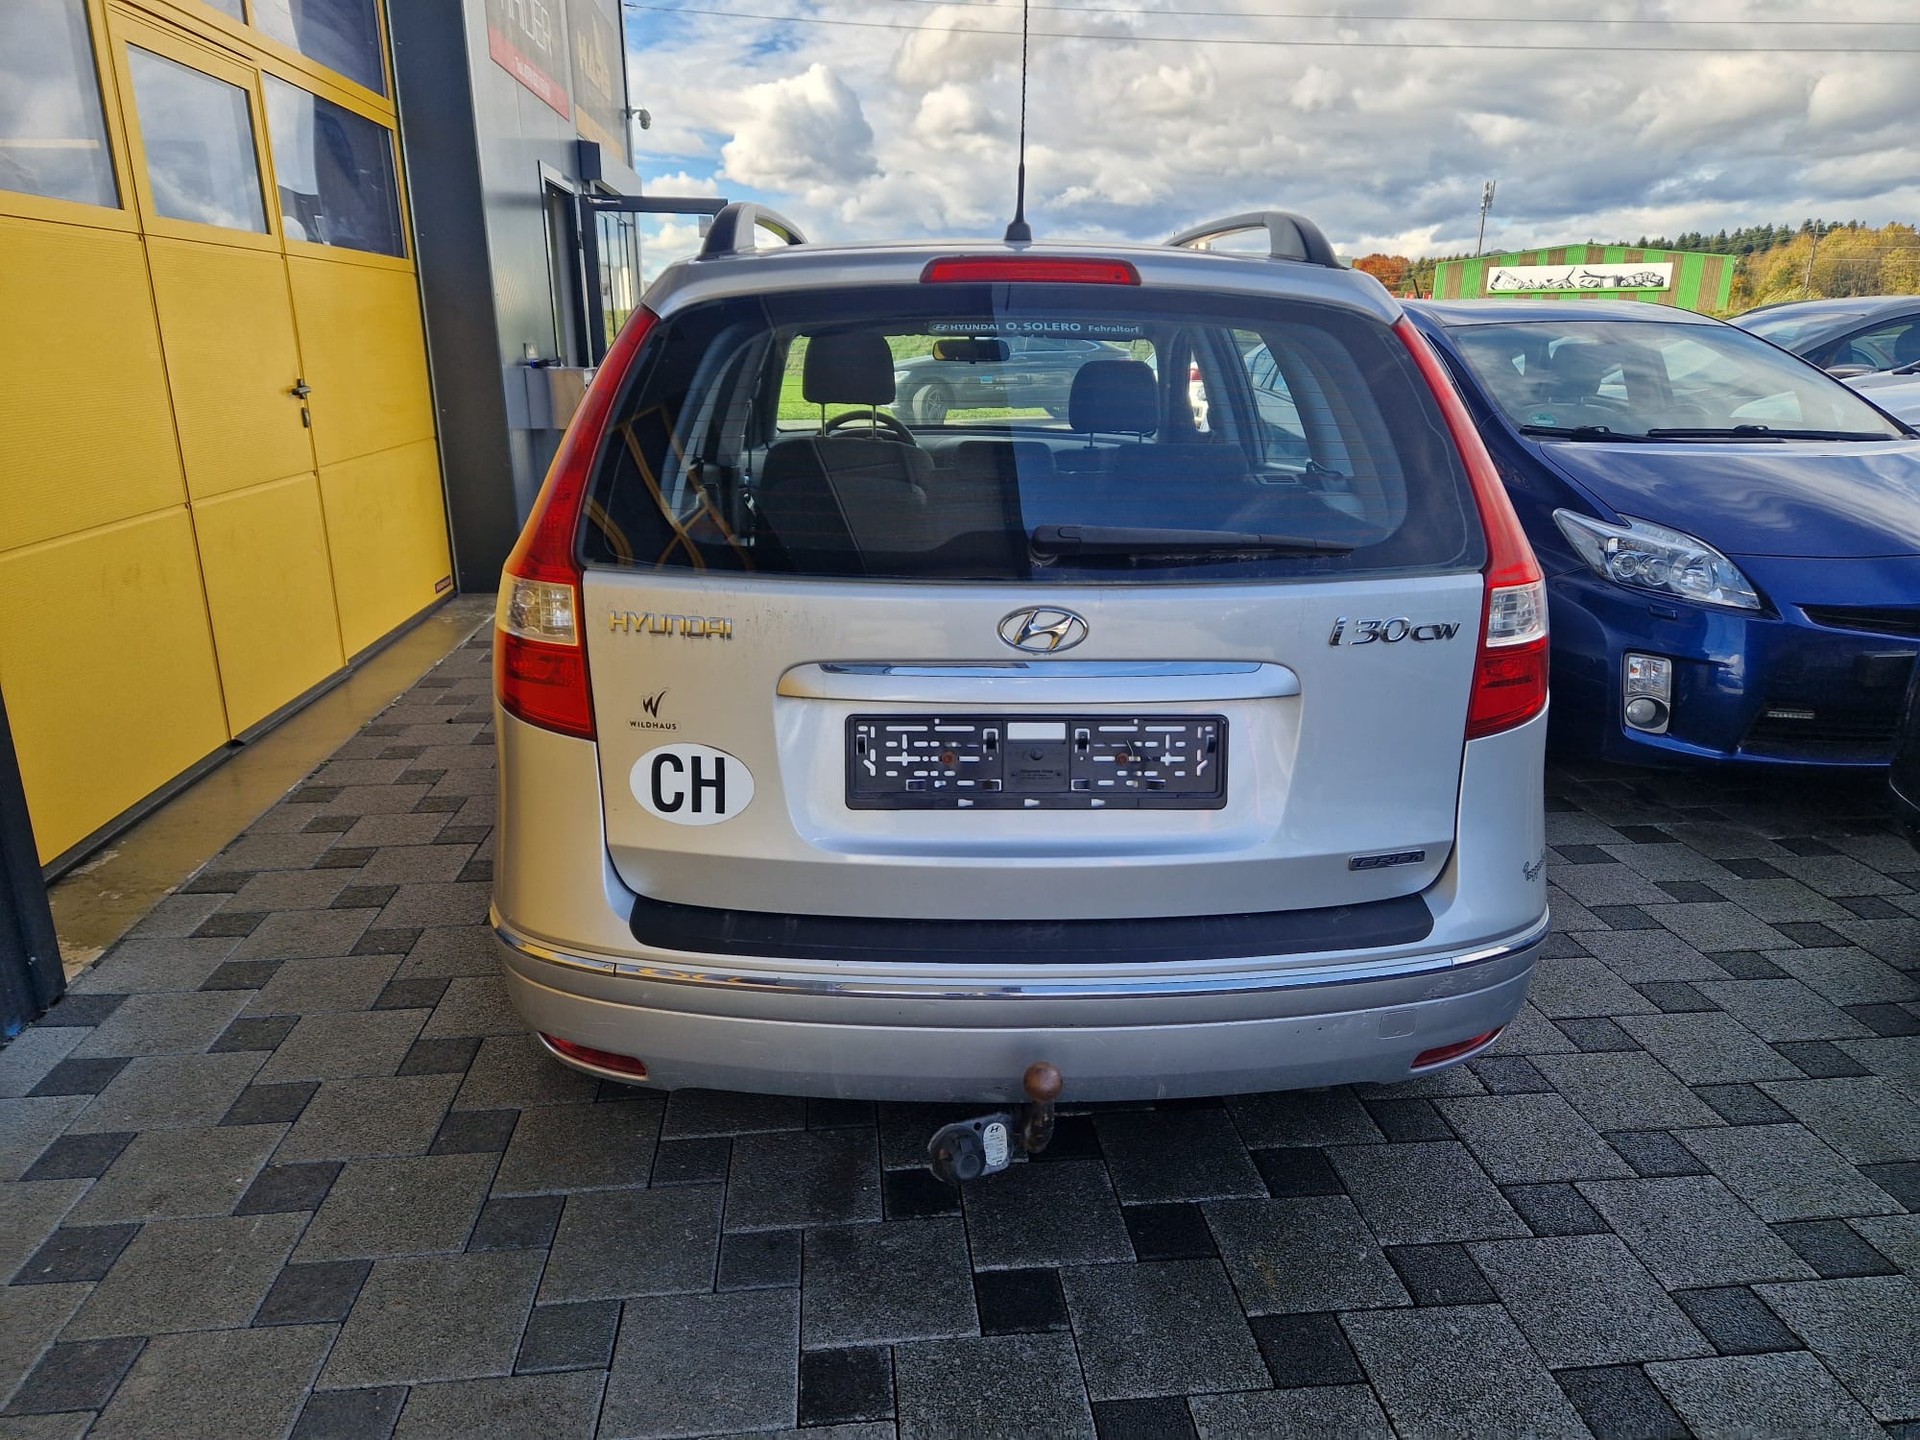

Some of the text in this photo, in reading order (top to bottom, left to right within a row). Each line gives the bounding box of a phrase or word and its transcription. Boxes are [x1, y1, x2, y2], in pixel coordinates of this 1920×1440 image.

[1088, 324, 1139, 333] Fehraltorf
[610, 611, 733, 640] HYUNDAI
[629, 720, 677, 731] WILDHAUS
[651, 753, 726, 815] CH
